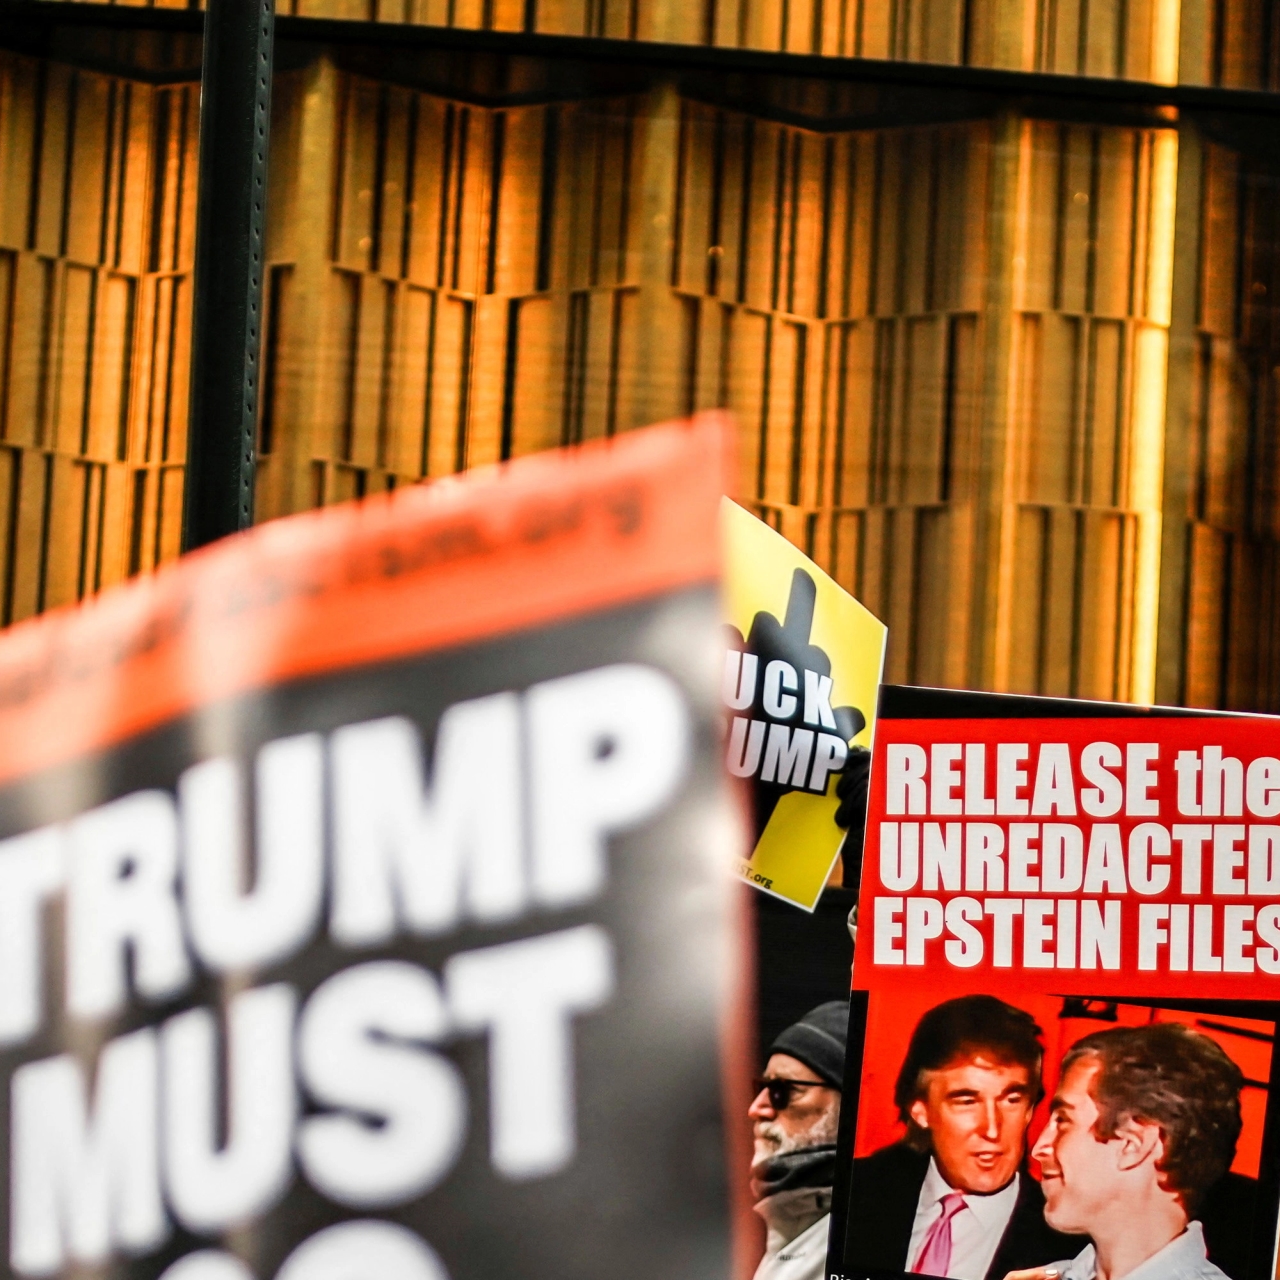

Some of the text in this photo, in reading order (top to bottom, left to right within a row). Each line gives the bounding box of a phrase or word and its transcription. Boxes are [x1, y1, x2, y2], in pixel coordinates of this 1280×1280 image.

[722, 650, 837, 730] UCK
[725, 716, 849, 791] UMP
[886, 741, 1161, 818] RELEASE
[873, 896, 1121, 970] EPSTEIN
[8, 922, 616, 1279] MUST
